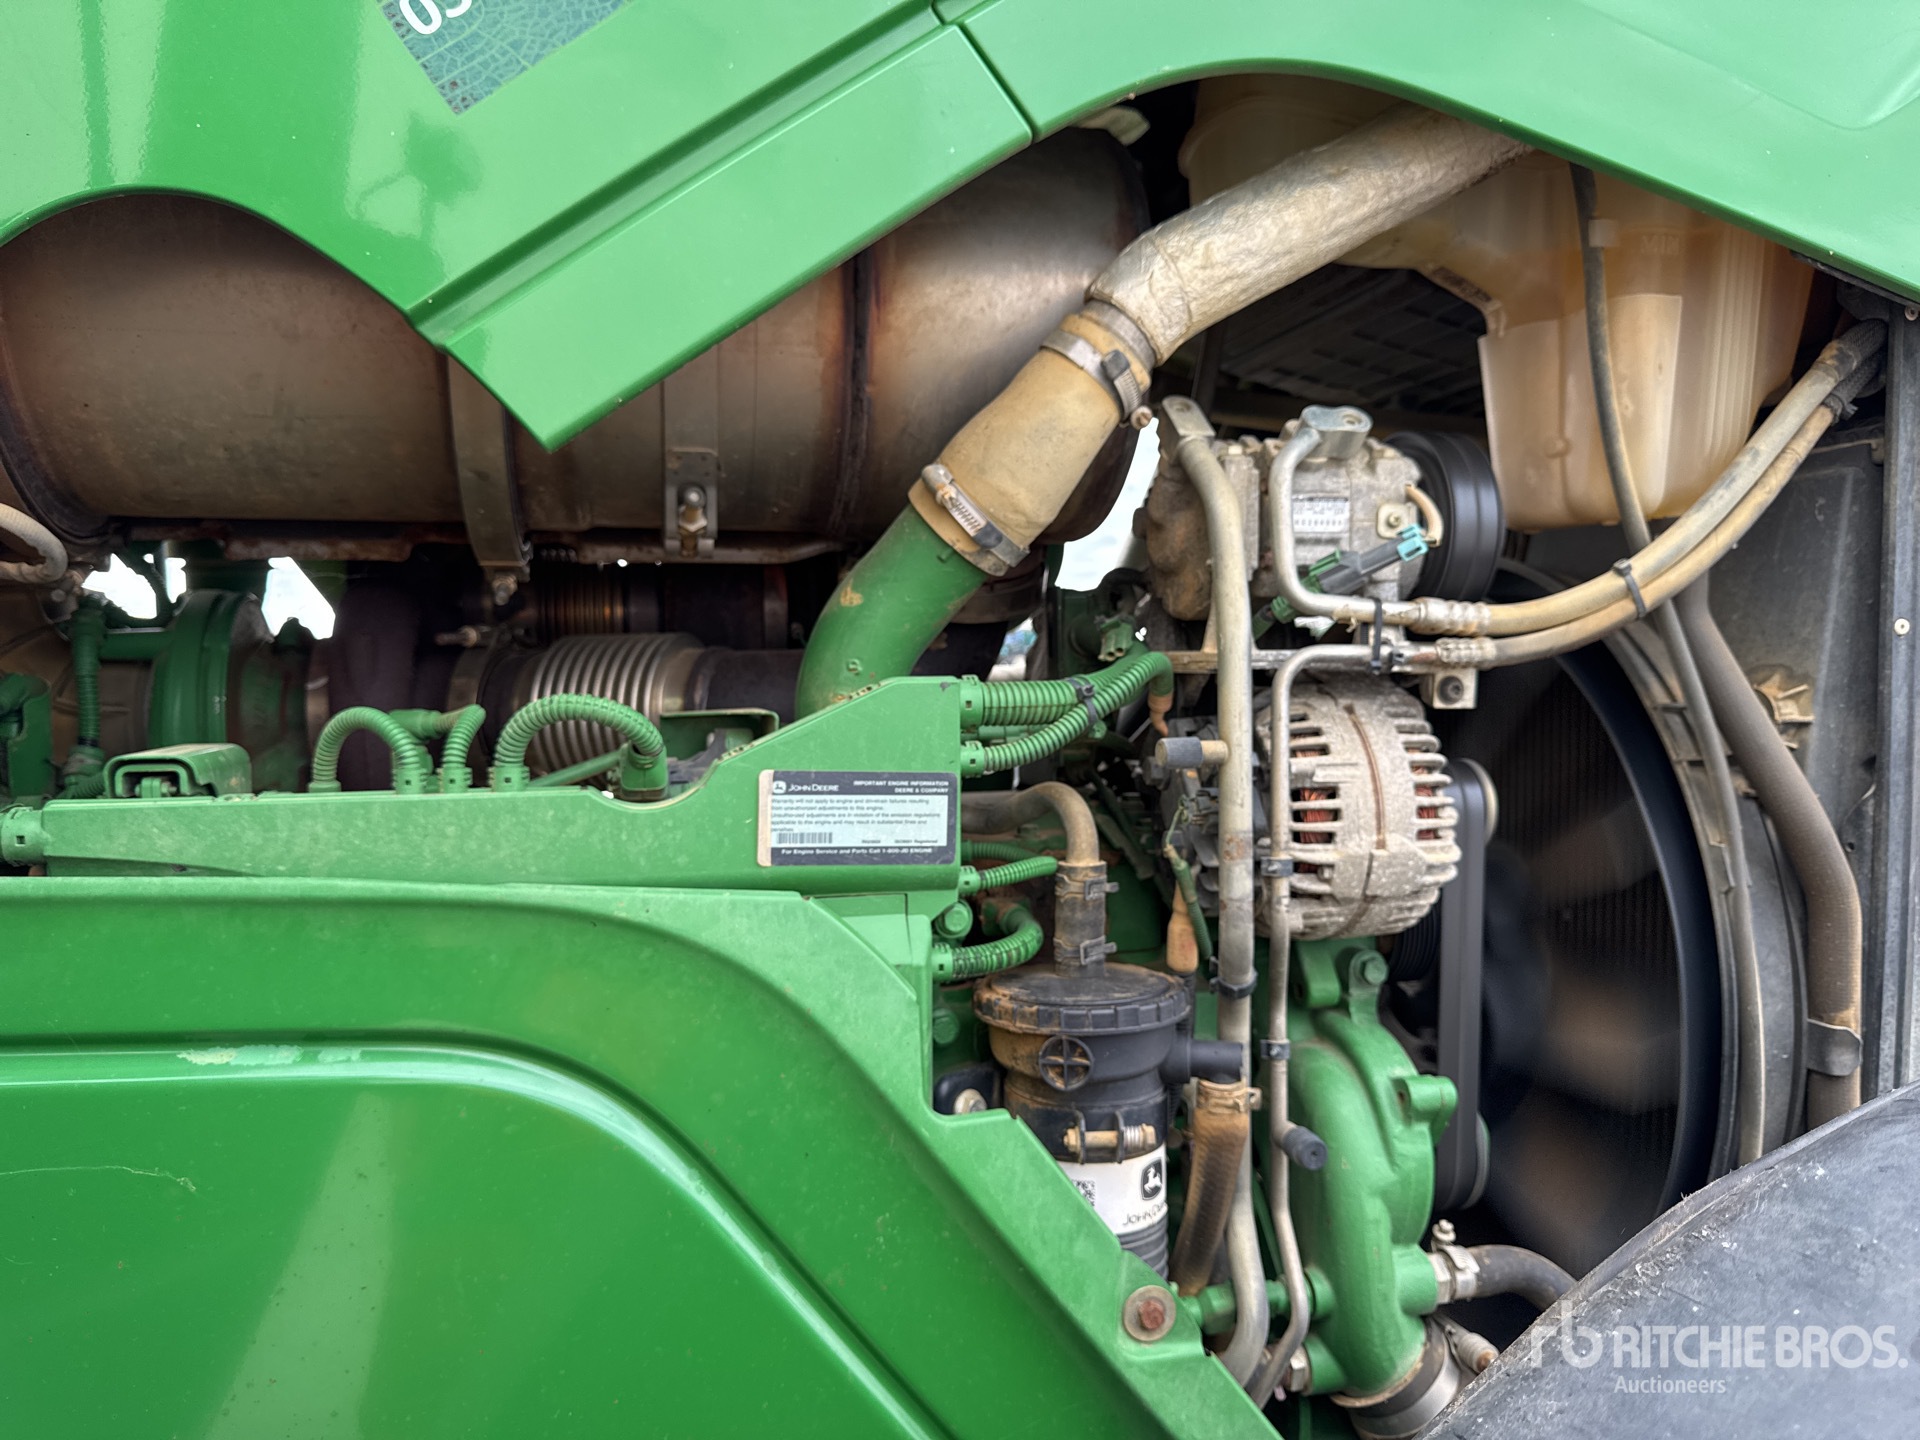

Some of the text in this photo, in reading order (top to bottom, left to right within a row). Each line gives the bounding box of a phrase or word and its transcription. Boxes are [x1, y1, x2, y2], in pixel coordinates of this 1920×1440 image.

[1640, 234, 1679, 255] MIN
[789, 783, 839, 792] JOHN DEERE
[1123, 1212, 1152, 1226] JOHN
